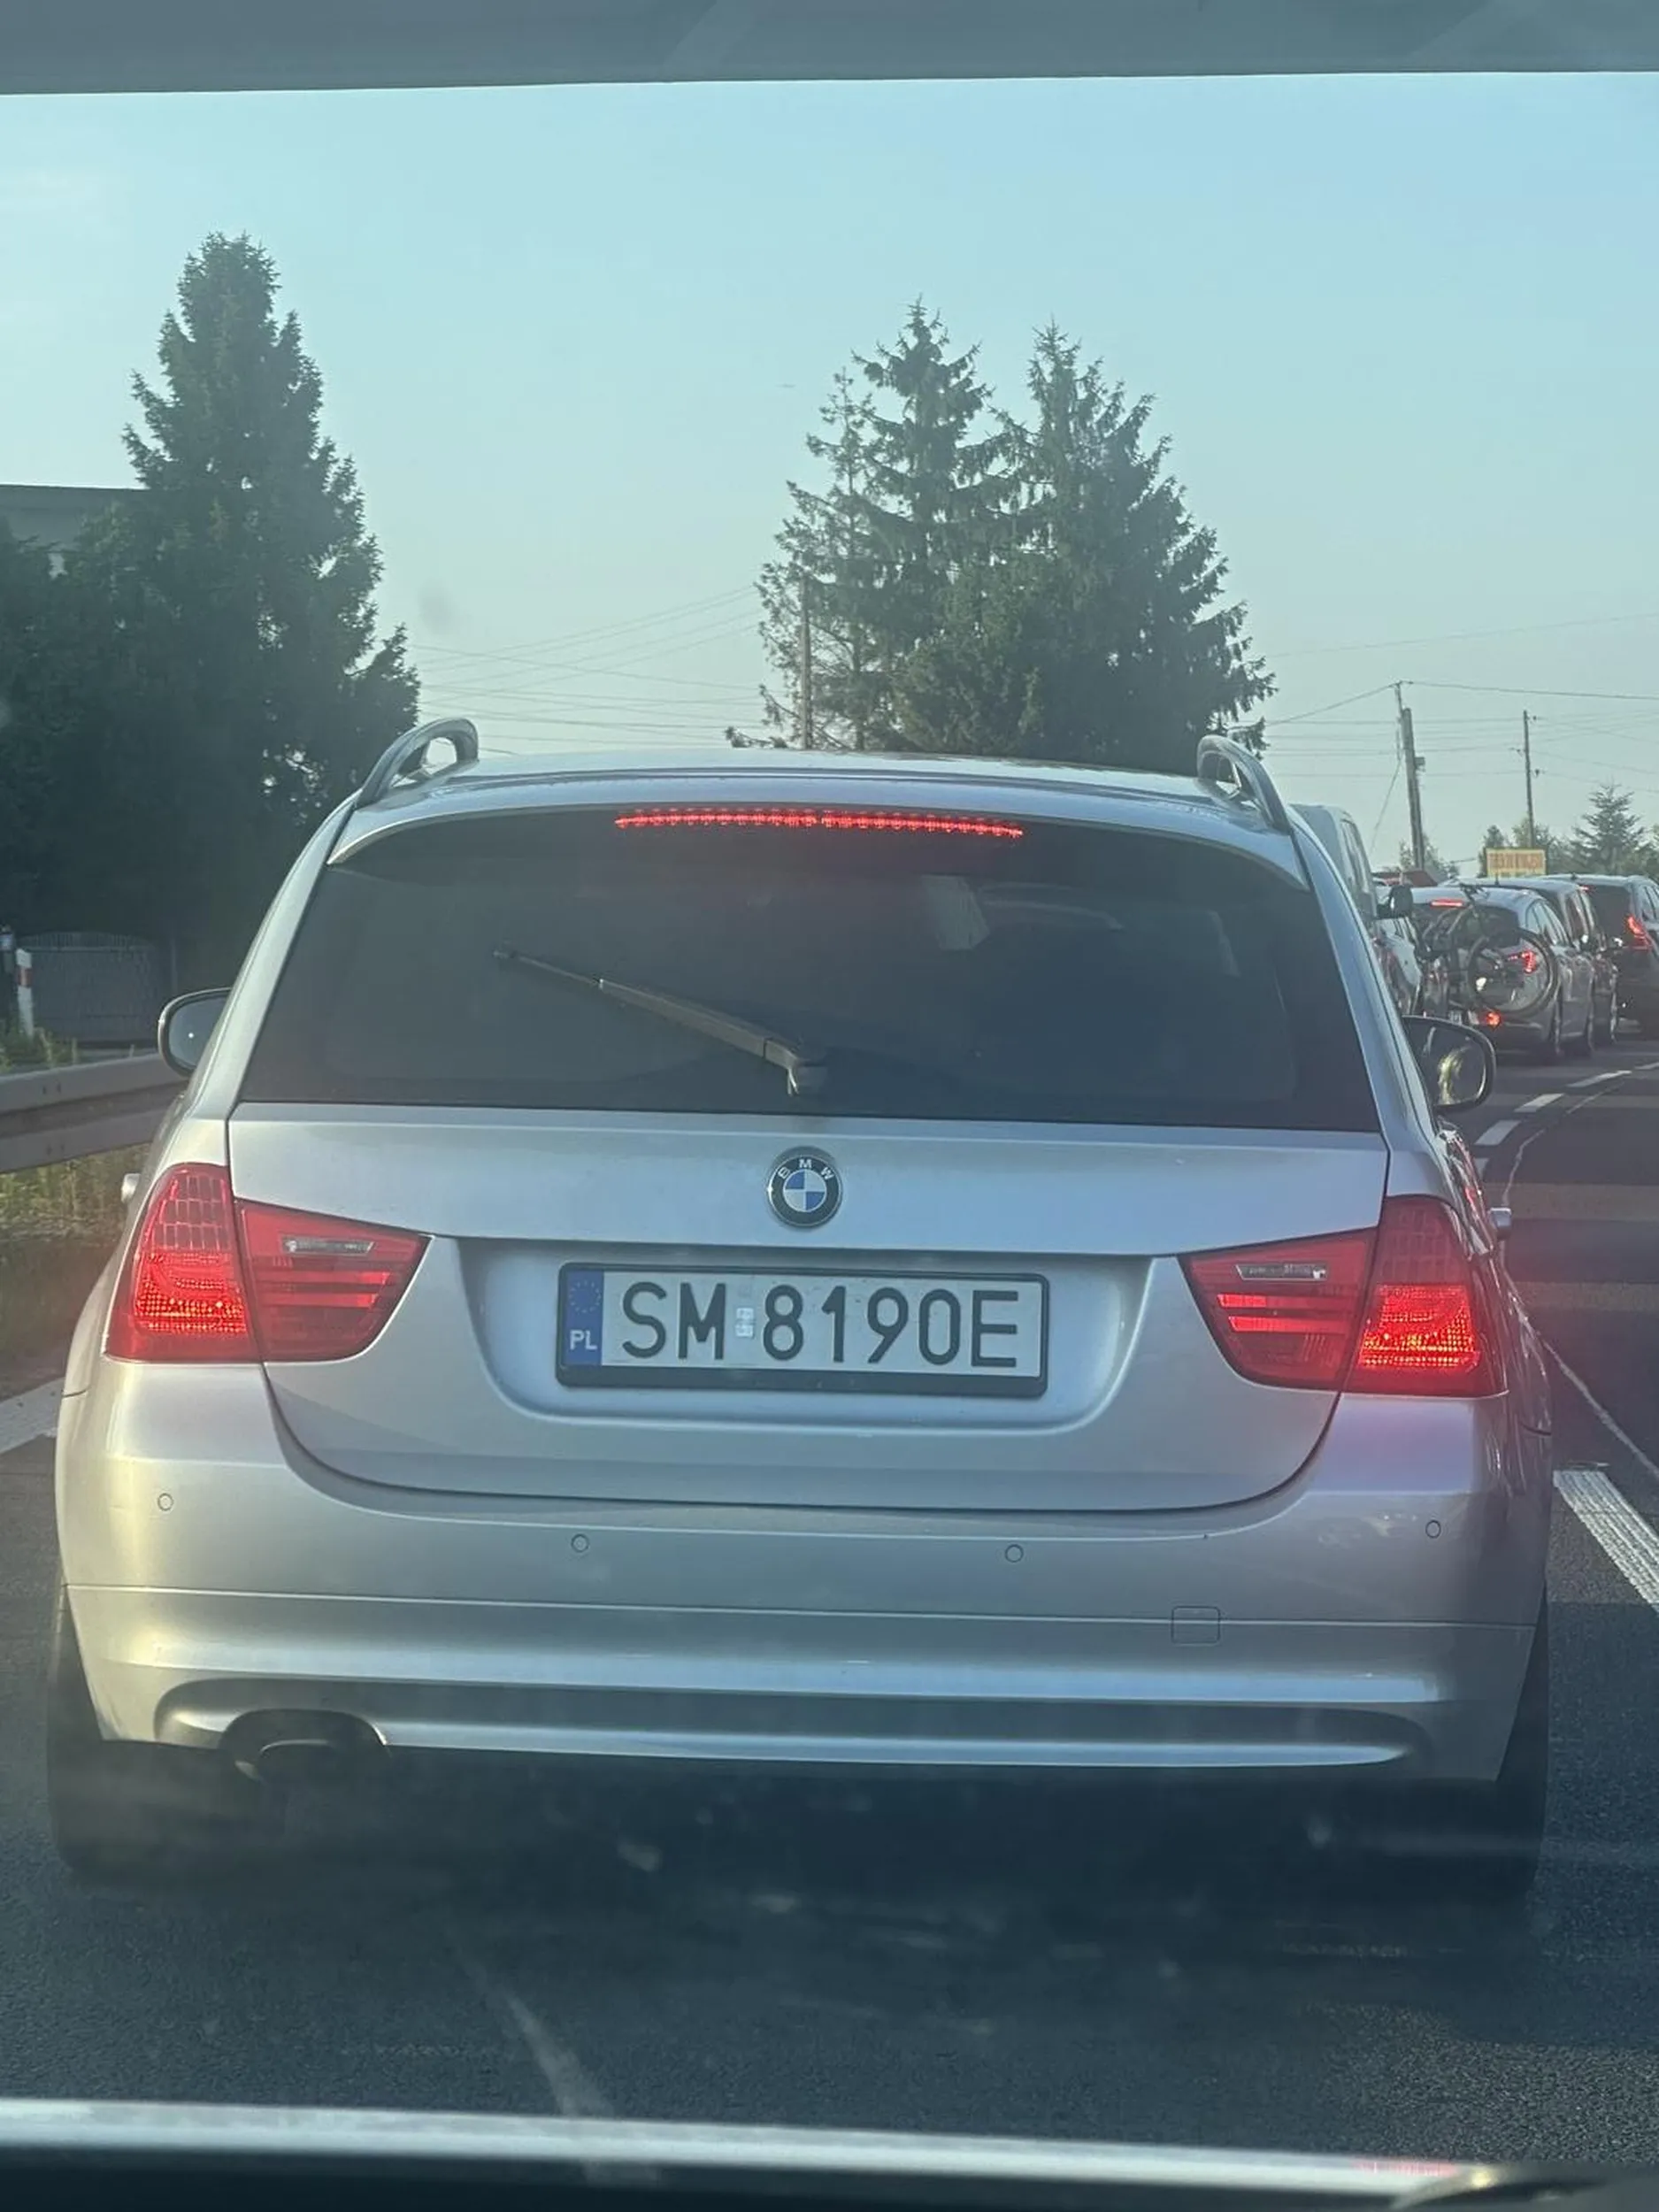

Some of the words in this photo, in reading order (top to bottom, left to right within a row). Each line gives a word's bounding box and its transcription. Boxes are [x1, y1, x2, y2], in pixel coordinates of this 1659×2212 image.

[777, 1158, 835, 1180] BMW
[621, 1280, 726, 1361] SM
[762, 1283, 1019, 1368] 8190E
[569, 1329, 598, 1351] PL
